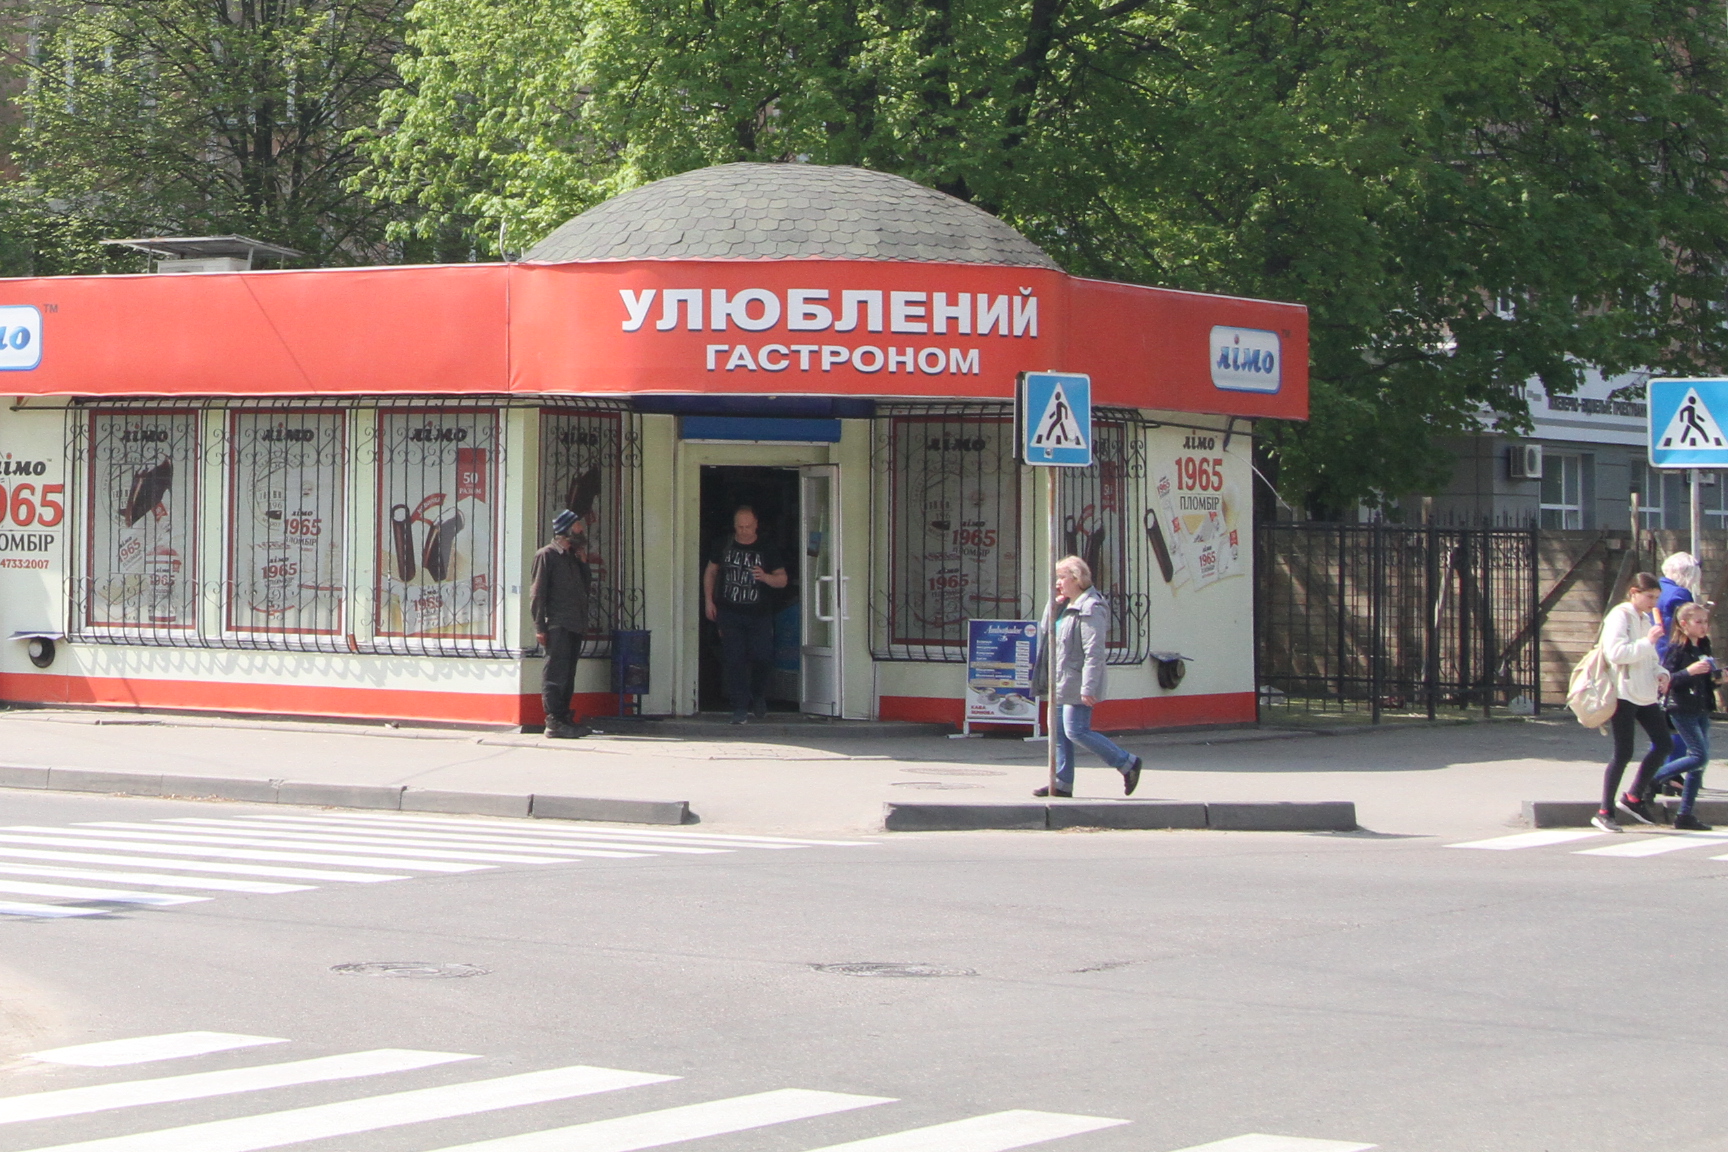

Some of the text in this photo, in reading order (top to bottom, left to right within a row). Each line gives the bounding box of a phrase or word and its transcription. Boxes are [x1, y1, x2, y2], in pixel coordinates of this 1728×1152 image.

[619, 286, 1038, 337] УЛЮБЛЕНИЙ
[706, 343, 979, 375] ГАСТРОНОМ
[1217, 334, 1274, 374] лімо
[1183, 430, 1215, 450] лімо
[1175, 457, 1224, 491] 1965
[1180, 496, 1220, 511] ПЛОМБІР
[284, 519, 321, 536] 1965
[952, 529, 996, 548] 1965
[119, 538, 141, 563] 965
[0, 558, 49, 569] 4733:2007
[261, 562, 298, 579] 1965
[928, 573, 970, 592] 1965
